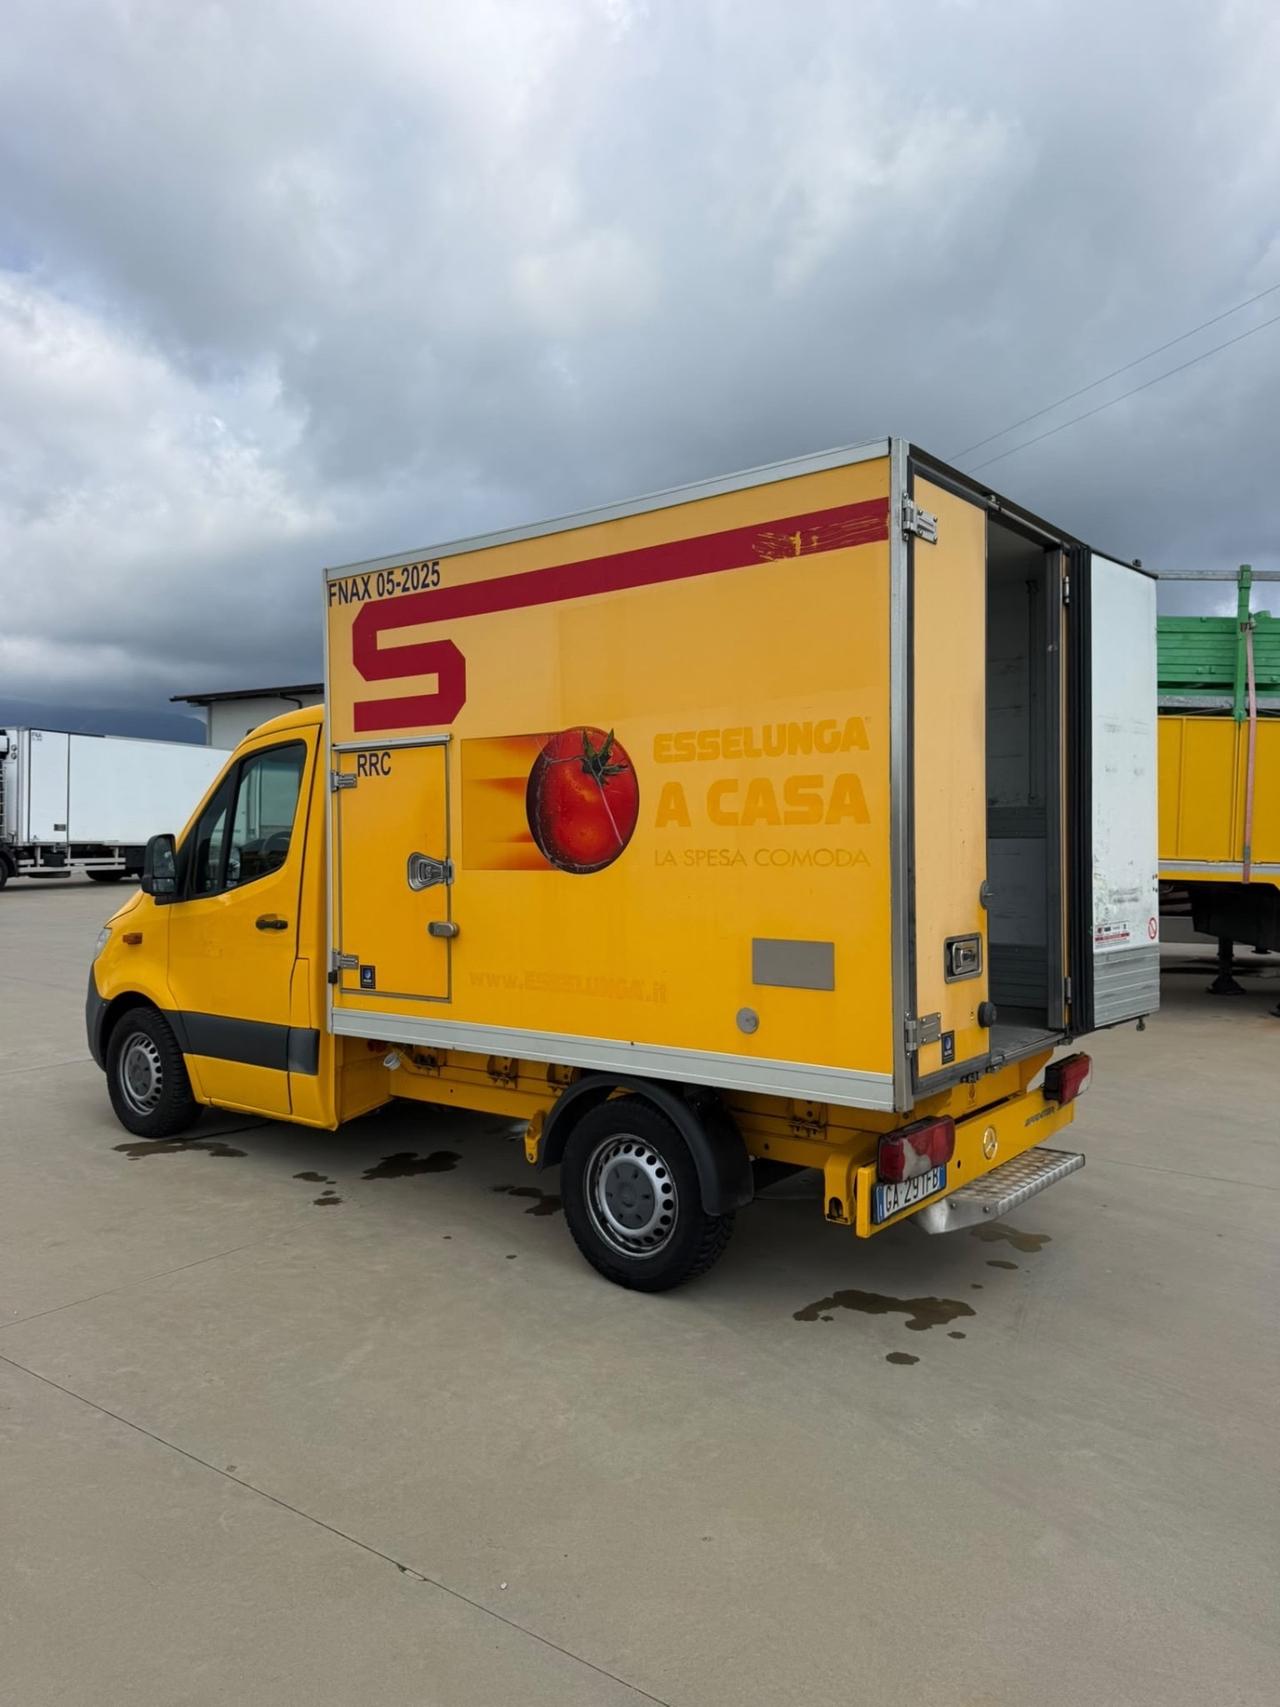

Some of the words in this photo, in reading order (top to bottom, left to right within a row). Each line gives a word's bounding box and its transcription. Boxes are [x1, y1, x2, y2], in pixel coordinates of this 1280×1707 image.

[328, 575, 372, 607] FNAX
[376, 561, 441, 597] 05-2025
[653, 716, 870, 764] ESSELUNGA
[357, 751, 391, 777] RRC
[655, 781, 692, 828] A
[706, 773, 871, 826] CASA
[654, 849, 677, 867] LA
[683, 849, 748, 867] SPESA
[754, 848, 871, 868] COMODA
